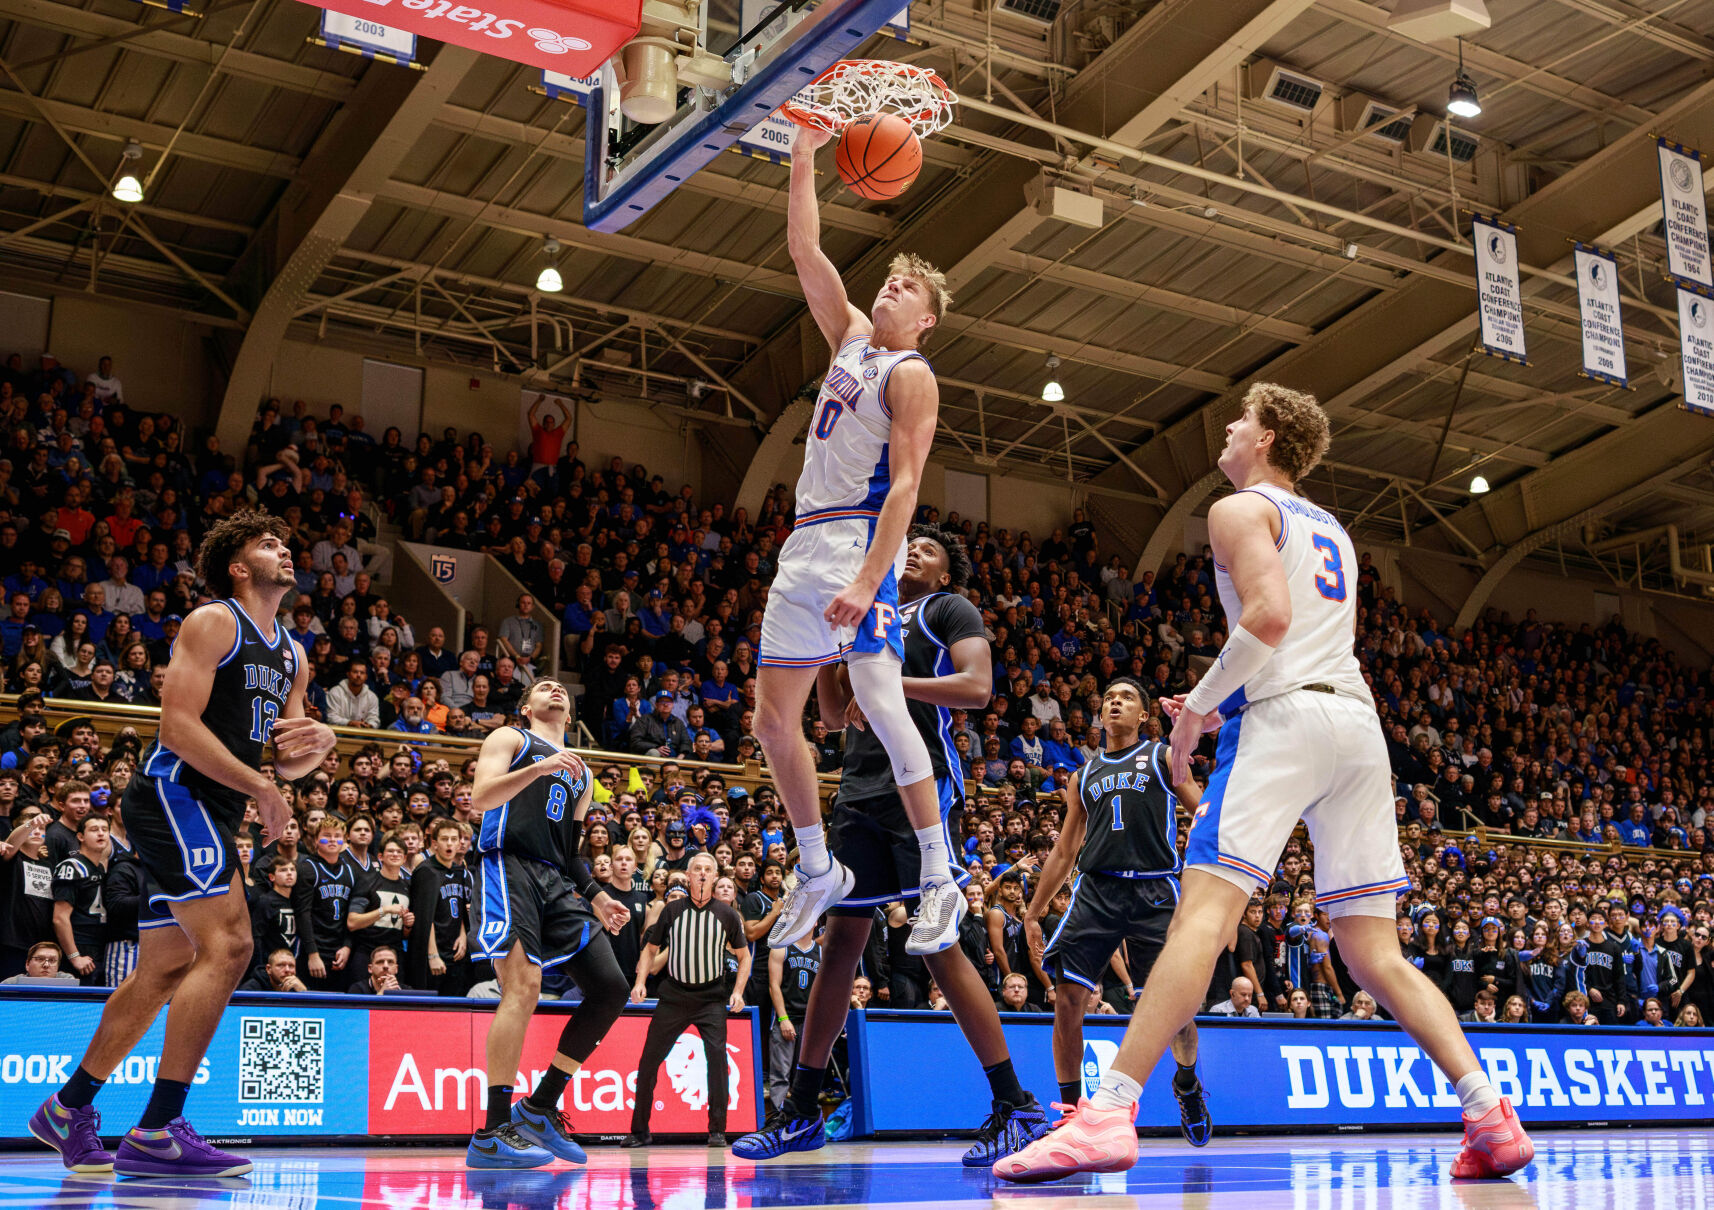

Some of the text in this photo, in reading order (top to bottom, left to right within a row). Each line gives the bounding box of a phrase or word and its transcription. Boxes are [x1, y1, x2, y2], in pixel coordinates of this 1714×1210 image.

[402, 0, 526, 39] State
[355, 20, 385, 38] 2003
[761, 128, 790, 146] 2005
[1672, 198, 1699, 216] ATLANTIC
[1677, 211, 1696, 227] COAST
[1668, 219, 1707, 242] CONFERENCE
[1671, 232, 1707, 253] CHAMPIONS
[1683, 261, 1701, 275] 1964
[1486, 271, 1513, 288] ATLANTIC
[1490, 284, 1510, 298] COAST
[1481, 292, 1521, 312] CONFERENCE
[1586, 298, 1614, 314] ATLANTIC
[1484, 304, 1520, 323] CHAMPIONS
[1593, 310, 1611, 323] COAST
[1583, 318, 1621, 337] CONFERENCE
[1585, 330, 1621, 348] CHAMPIONS
[1687, 334, 1713, 350] ATLANTIC
[1693, 346, 1710, 360] COAST
[822, 365, 864, 412] ORIDA
[1697, 391, 1714, 404] 2010
[435, 561, 453, 579] 15
[1312, 531, 1348, 604] 3
[873, 601, 896, 640] F
[244, 664, 292, 704] DUKE
[250, 696, 279, 745] 12
[1089, 771, 1150, 801] DUKE
[546, 783, 568, 822] 8
[1111, 794, 1125, 831] 1
[58, 865, 74, 880] 48
[319, 883, 351, 901] DUKE
[333, 899, 340, 920] 1
[788, 956, 820, 974] DUKE
[1452, 959, 1473, 972] UK
[799, 969, 809, 990] 0
[0, 1055, 72, 1084] OOK
[237, 1109, 324, 1126] JOIN NOW
